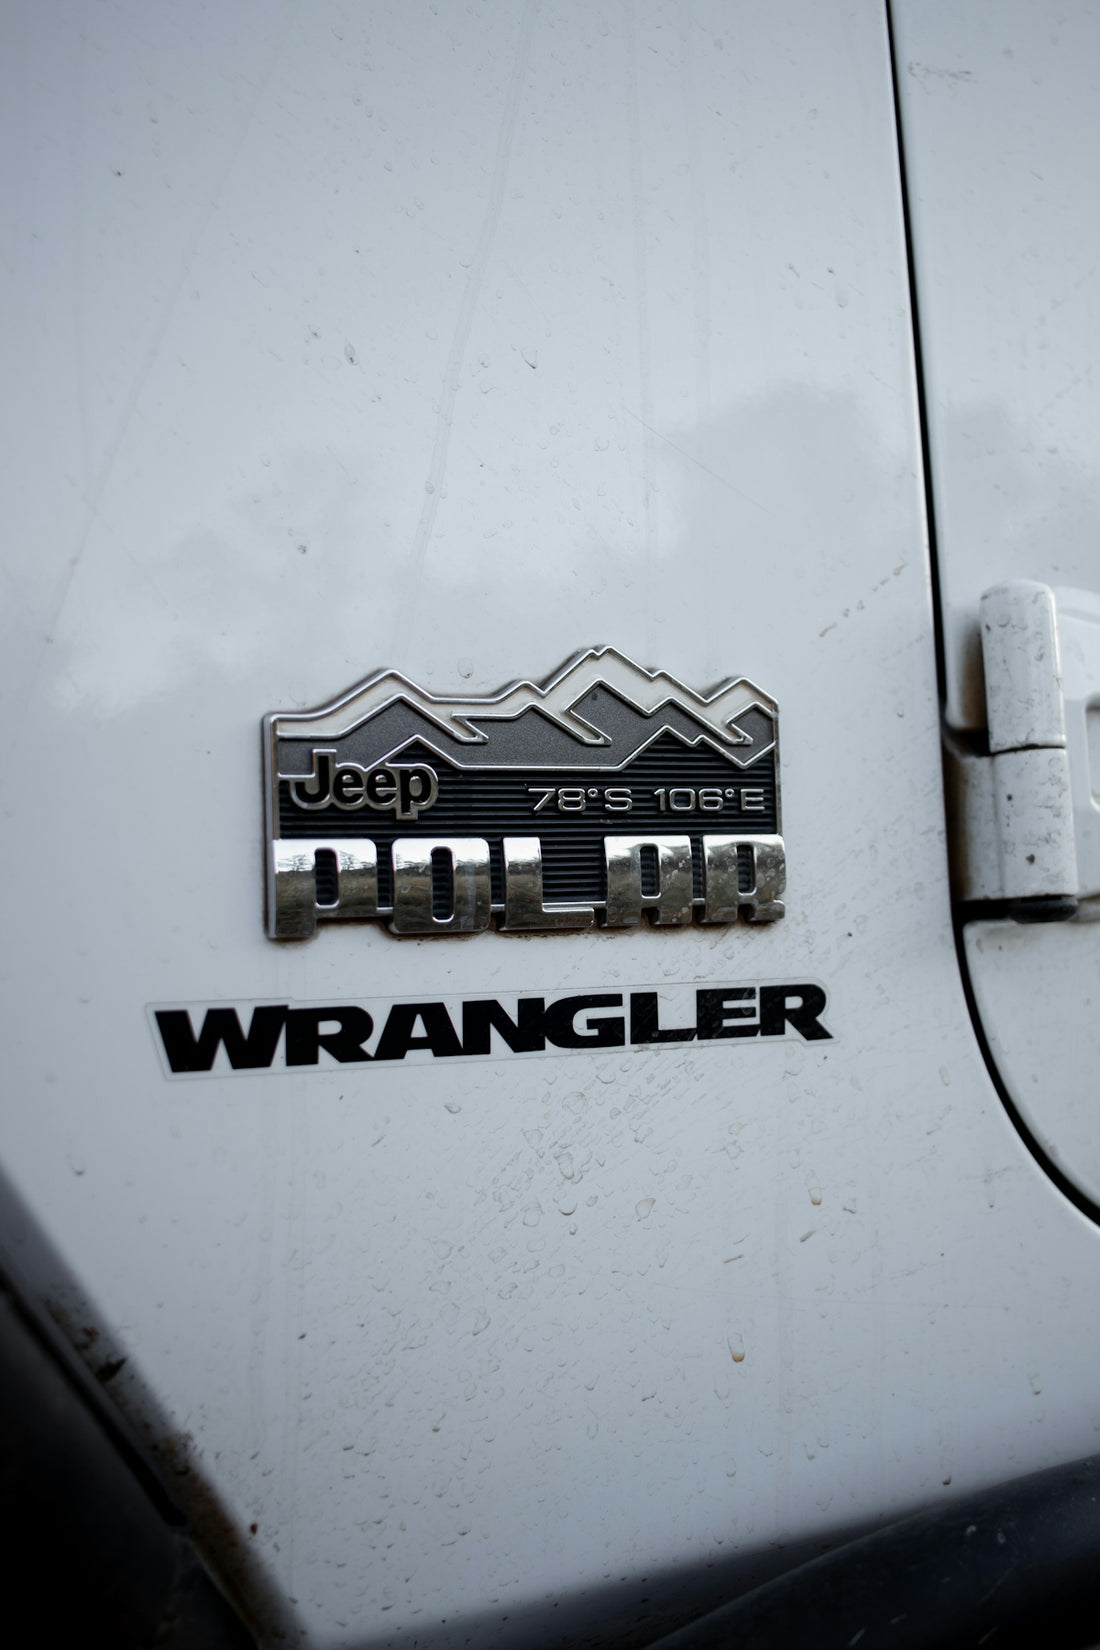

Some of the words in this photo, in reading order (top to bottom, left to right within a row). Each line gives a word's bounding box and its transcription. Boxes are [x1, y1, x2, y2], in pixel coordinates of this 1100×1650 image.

[291, 750, 438, 820] Jeep
[527, 787, 633, 812] 78°S
[653, 787, 765, 812] 106°E
[269, 834, 786, 938] POLAR
[155, 984, 834, 1073] WRANGLER
